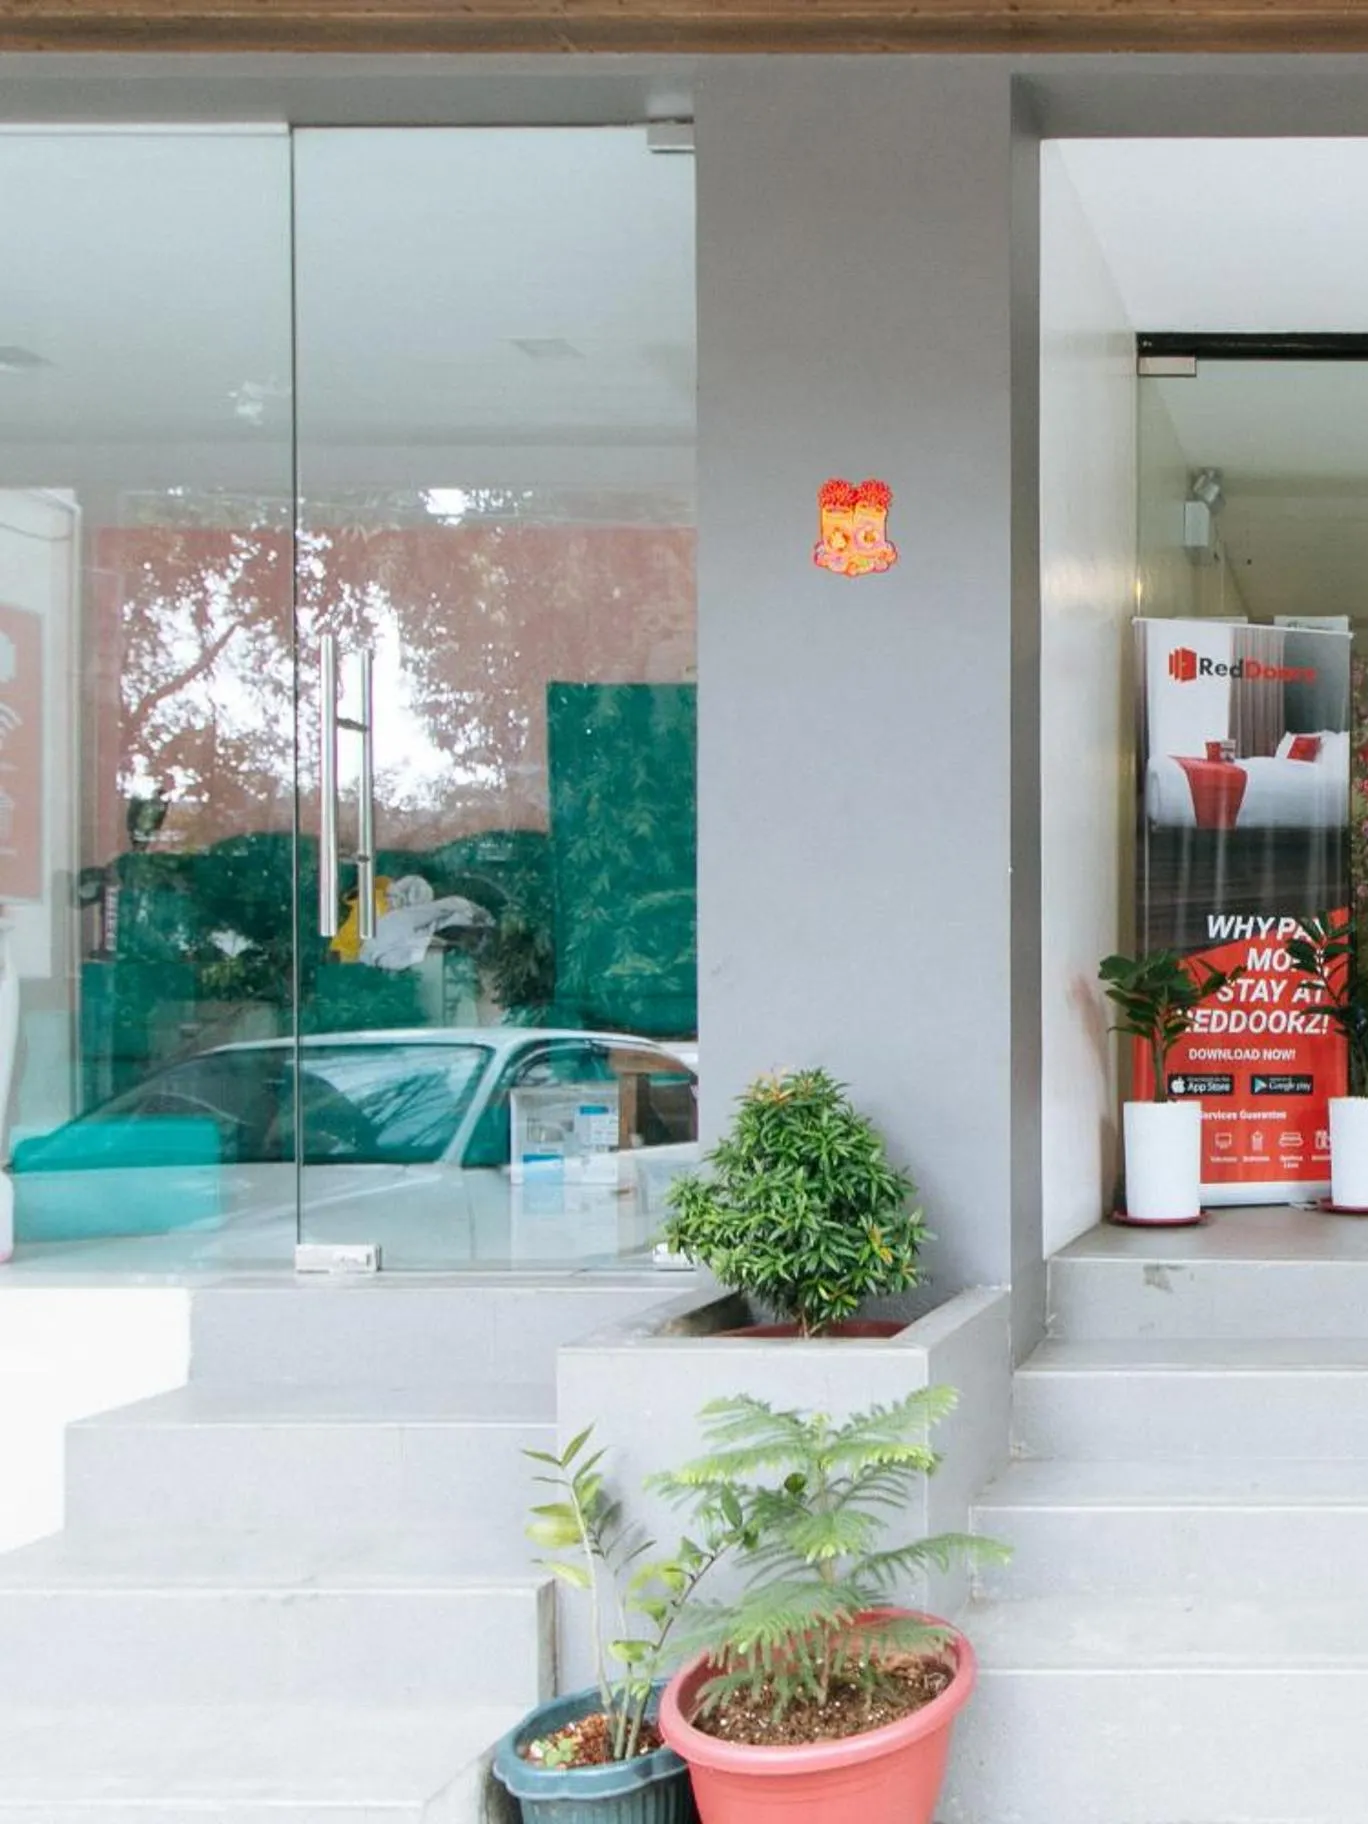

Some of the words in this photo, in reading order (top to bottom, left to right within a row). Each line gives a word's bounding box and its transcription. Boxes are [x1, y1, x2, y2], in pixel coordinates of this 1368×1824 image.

[1207, 914, 1275, 940] WHY
[1216, 978, 1288, 1003] STAY
[1292, 980, 1326, 1003] AT
[1185, 1009, 1329, 1034] EDDOORZ!
[1188, 1048, 1260, 1060] DOWNLOAD
[1263, 1048, 1296, 1060] NOW!
[1187, 1082, 1206, 1093] App
[1208, 1081, 1231, 1092] Store
